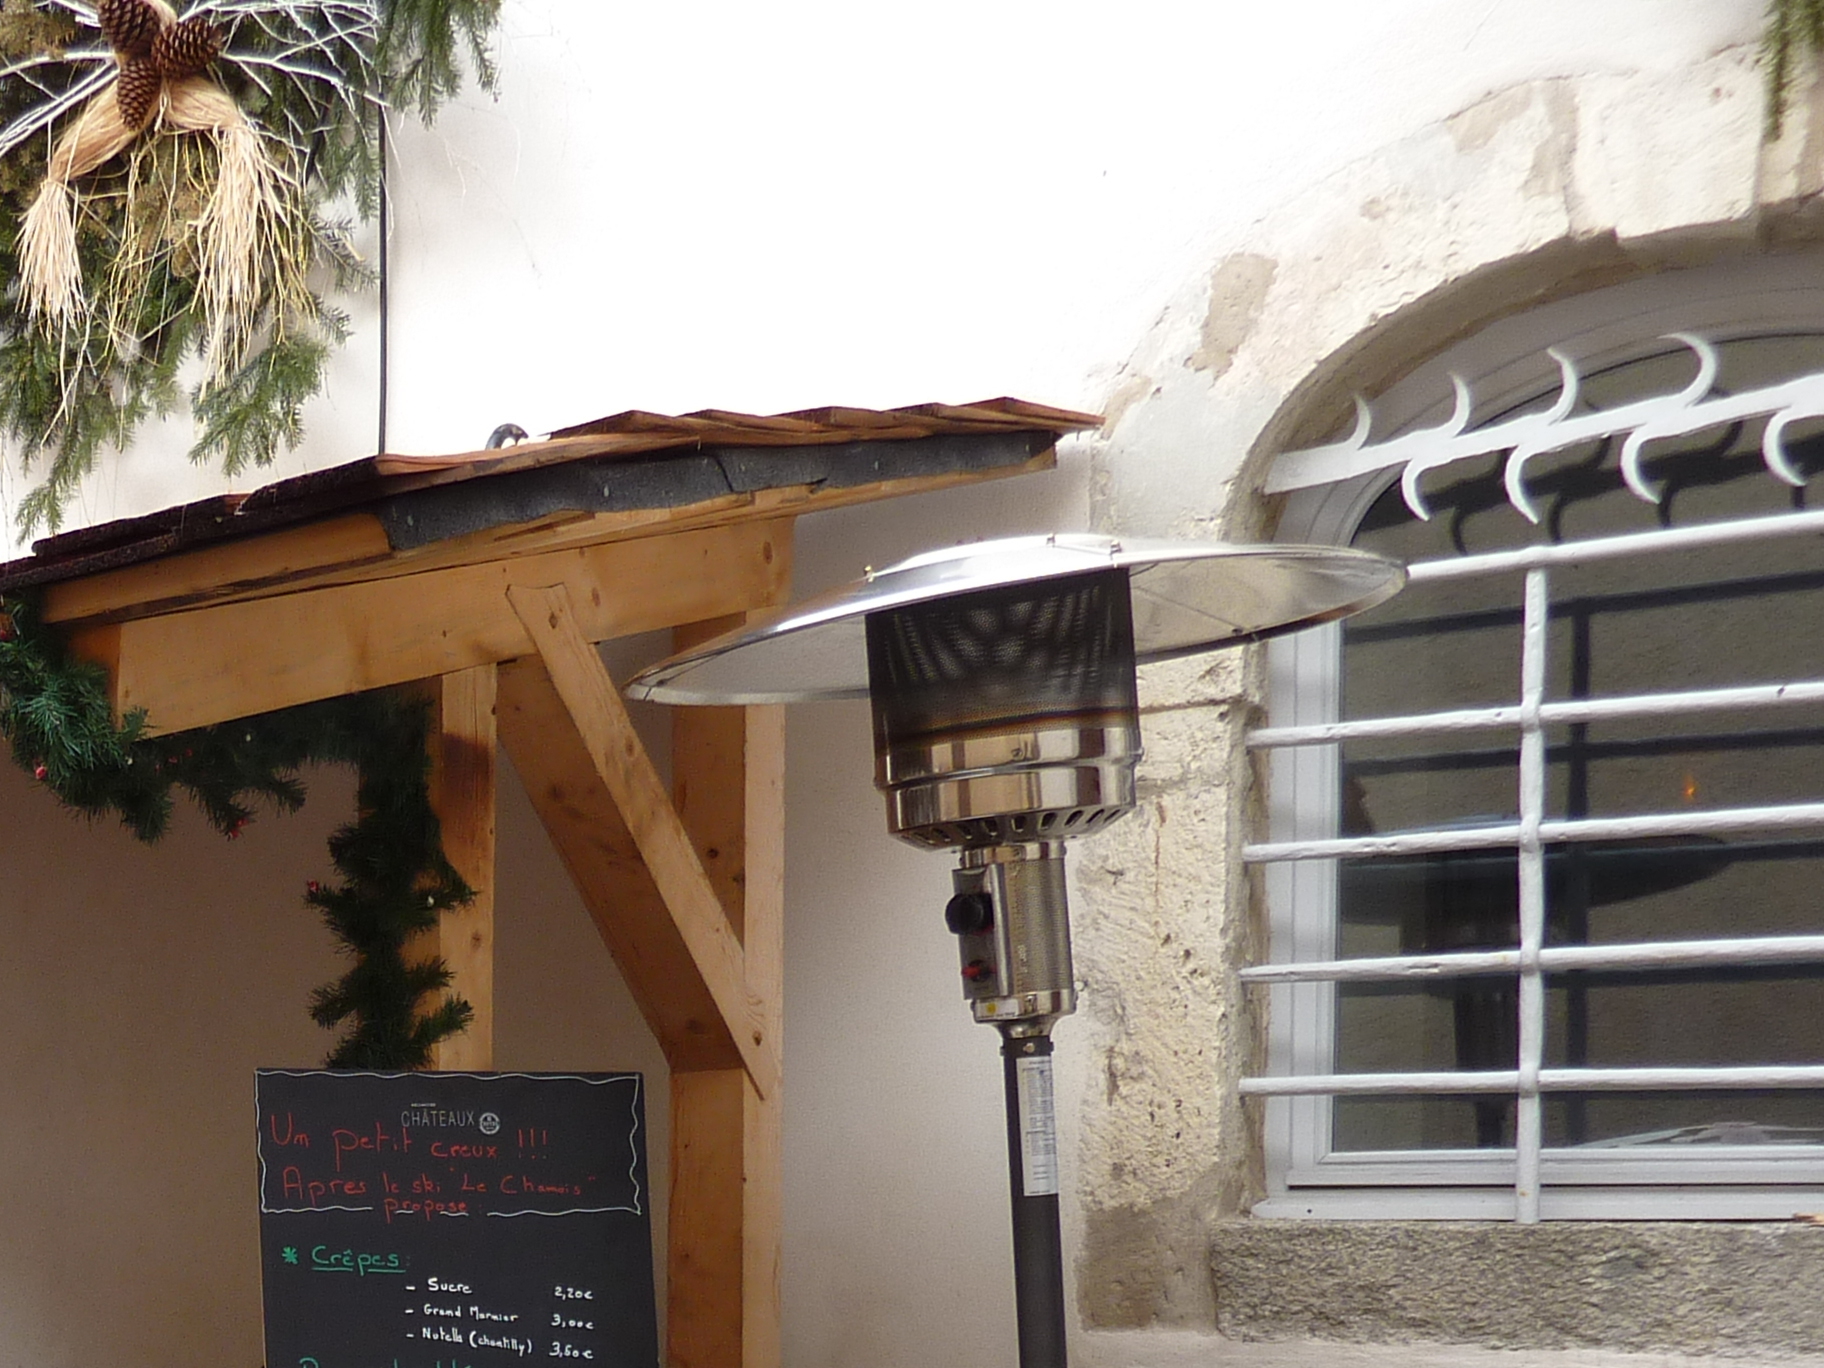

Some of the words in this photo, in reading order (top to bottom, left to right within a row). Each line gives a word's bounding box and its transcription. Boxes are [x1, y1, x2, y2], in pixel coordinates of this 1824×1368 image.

[271, 1112, 311, 1148] Un
[331, 1121, 413, 1172] petit
[430, 1142, 498, 1158] creux
[382, 1172, 400, 1193] le
[412, 1173, 441, 1193] ski
[427, 1277, 473, 1294] Sucre
[423, 1303, 462, 1317] Grand
[469, 1306, 519, 1322] Marnier
[422, 1327, 463, 1343] Nutella
